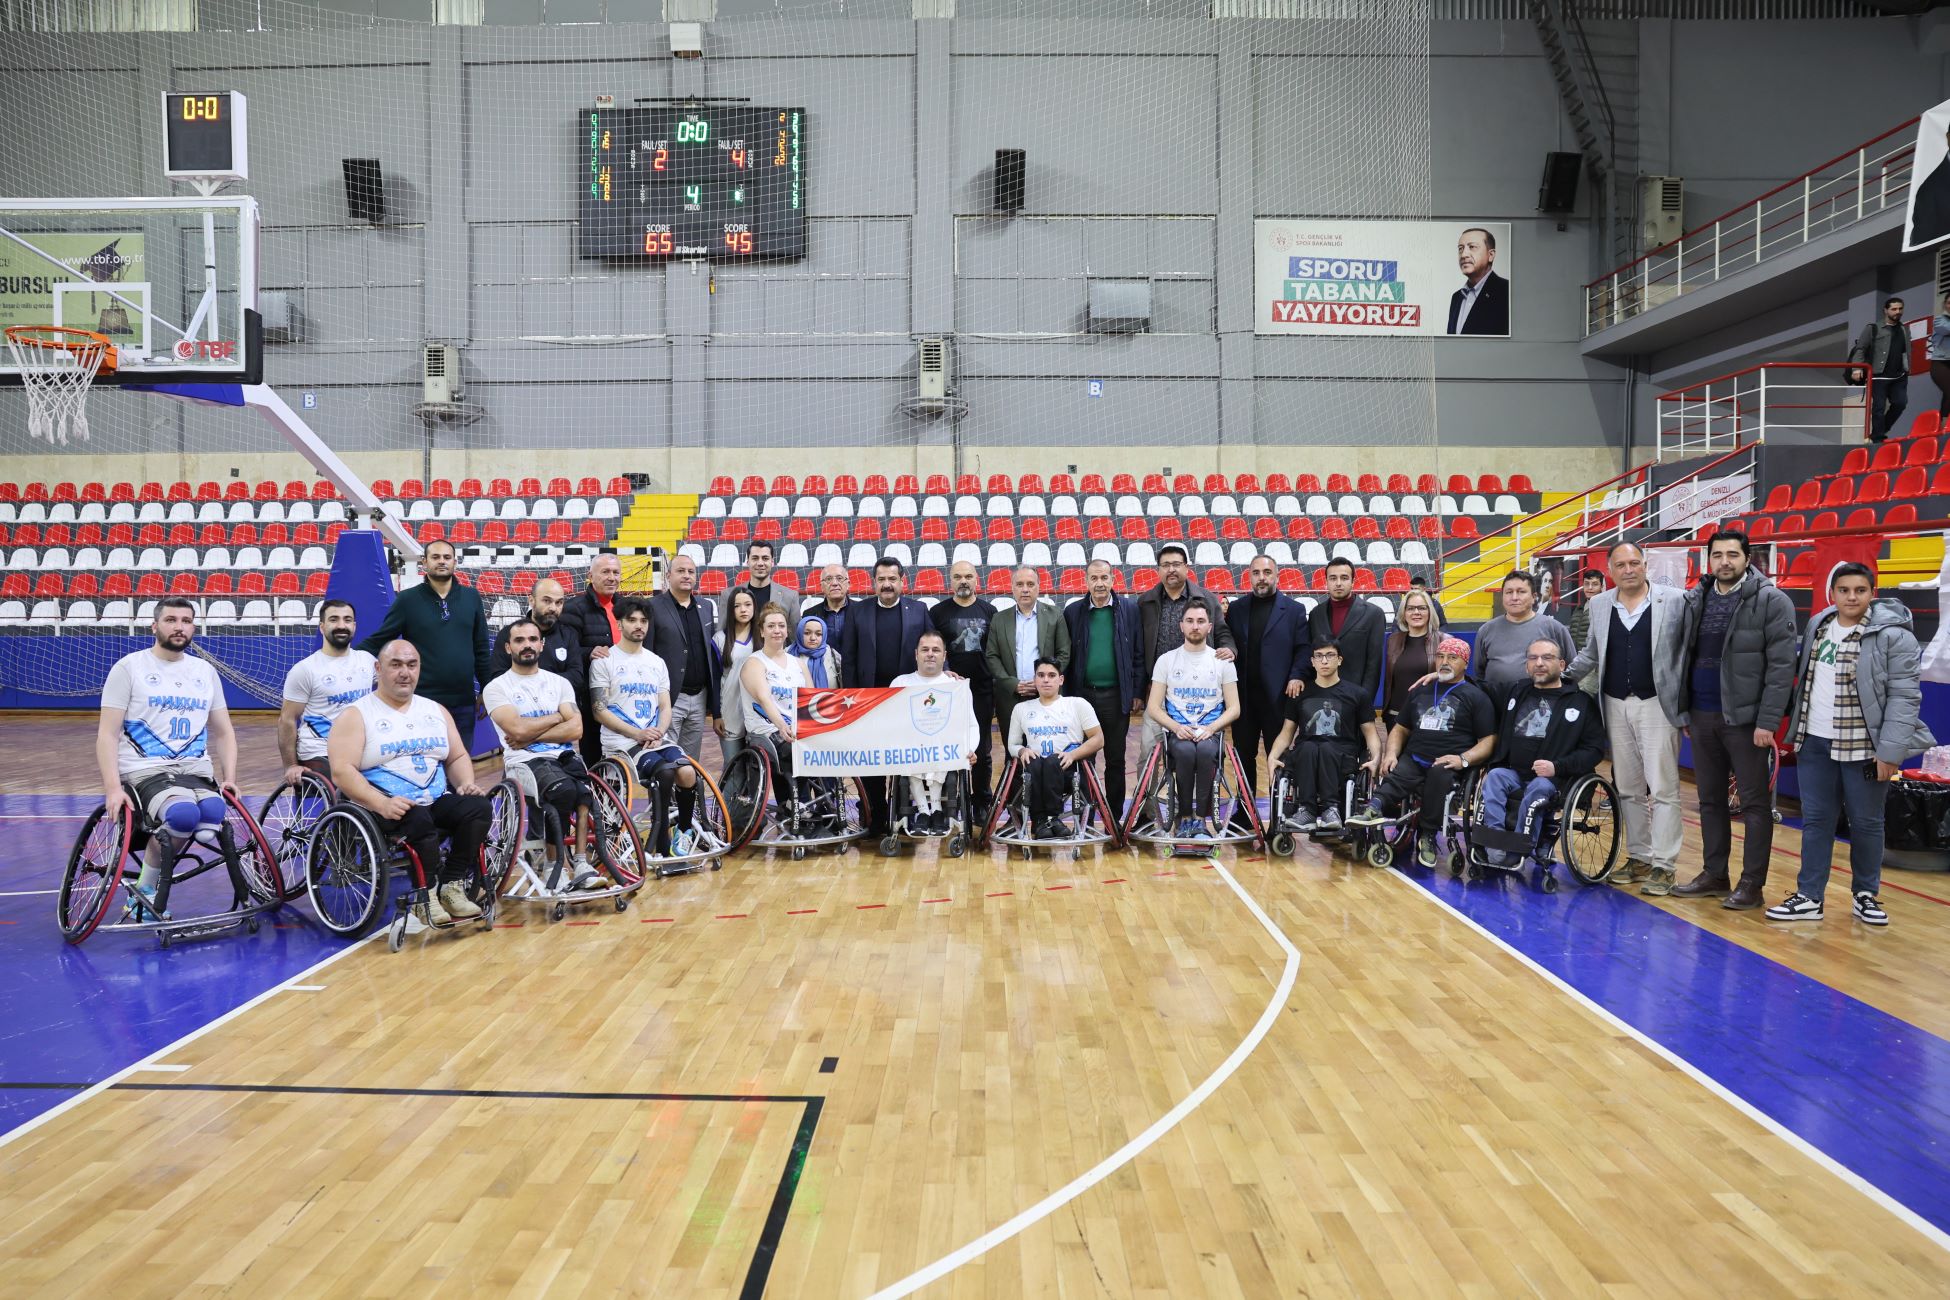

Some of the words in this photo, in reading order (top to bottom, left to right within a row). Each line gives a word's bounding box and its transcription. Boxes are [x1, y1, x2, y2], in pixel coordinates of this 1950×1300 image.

[184, 97, 217, 119] 0:0
[686, 114, 699, 122] TIME
[678, 121, 707, 141] 0:0
[641, 140, 668, 150] FAUL/SET
[718, 140, 743, 150] FAUL/SET
[654, 149, 667, 169] 2
[732, 149, 744, 168] 4
[687, 186, 699, 204] 4
[646, 224, 671, 233] SCORE
[724, 224, 749, 233] SCORE
[646, 232, 672, 253] 65
[726, 232, 751, 253] 45
[60, 253, 144, 265] www.tbf.org.tr
[1298, 259, 1383, 280] SPORU
[1291, 282, 1395, 301] TABANA
[1276, 302, 1416, 325] YAYIYORUZ
[196, 341, 237, 359] TBF
[1090, 381, 1100, 396] B
[304, 393, 315, 407] B
[148, 695, 208, 711] PAMUKKALE
[634, 699, 651, 719] 58
[168, 716, 191, 741] 10
[803, 750, 881, 767] PAMUKKALE
[884, 743, 940, 765] BELEDİYE
[943, 744, 961, 761] SK
[1040, 739, 1054, 755] 11
[410, 754, 428, 774] 9
